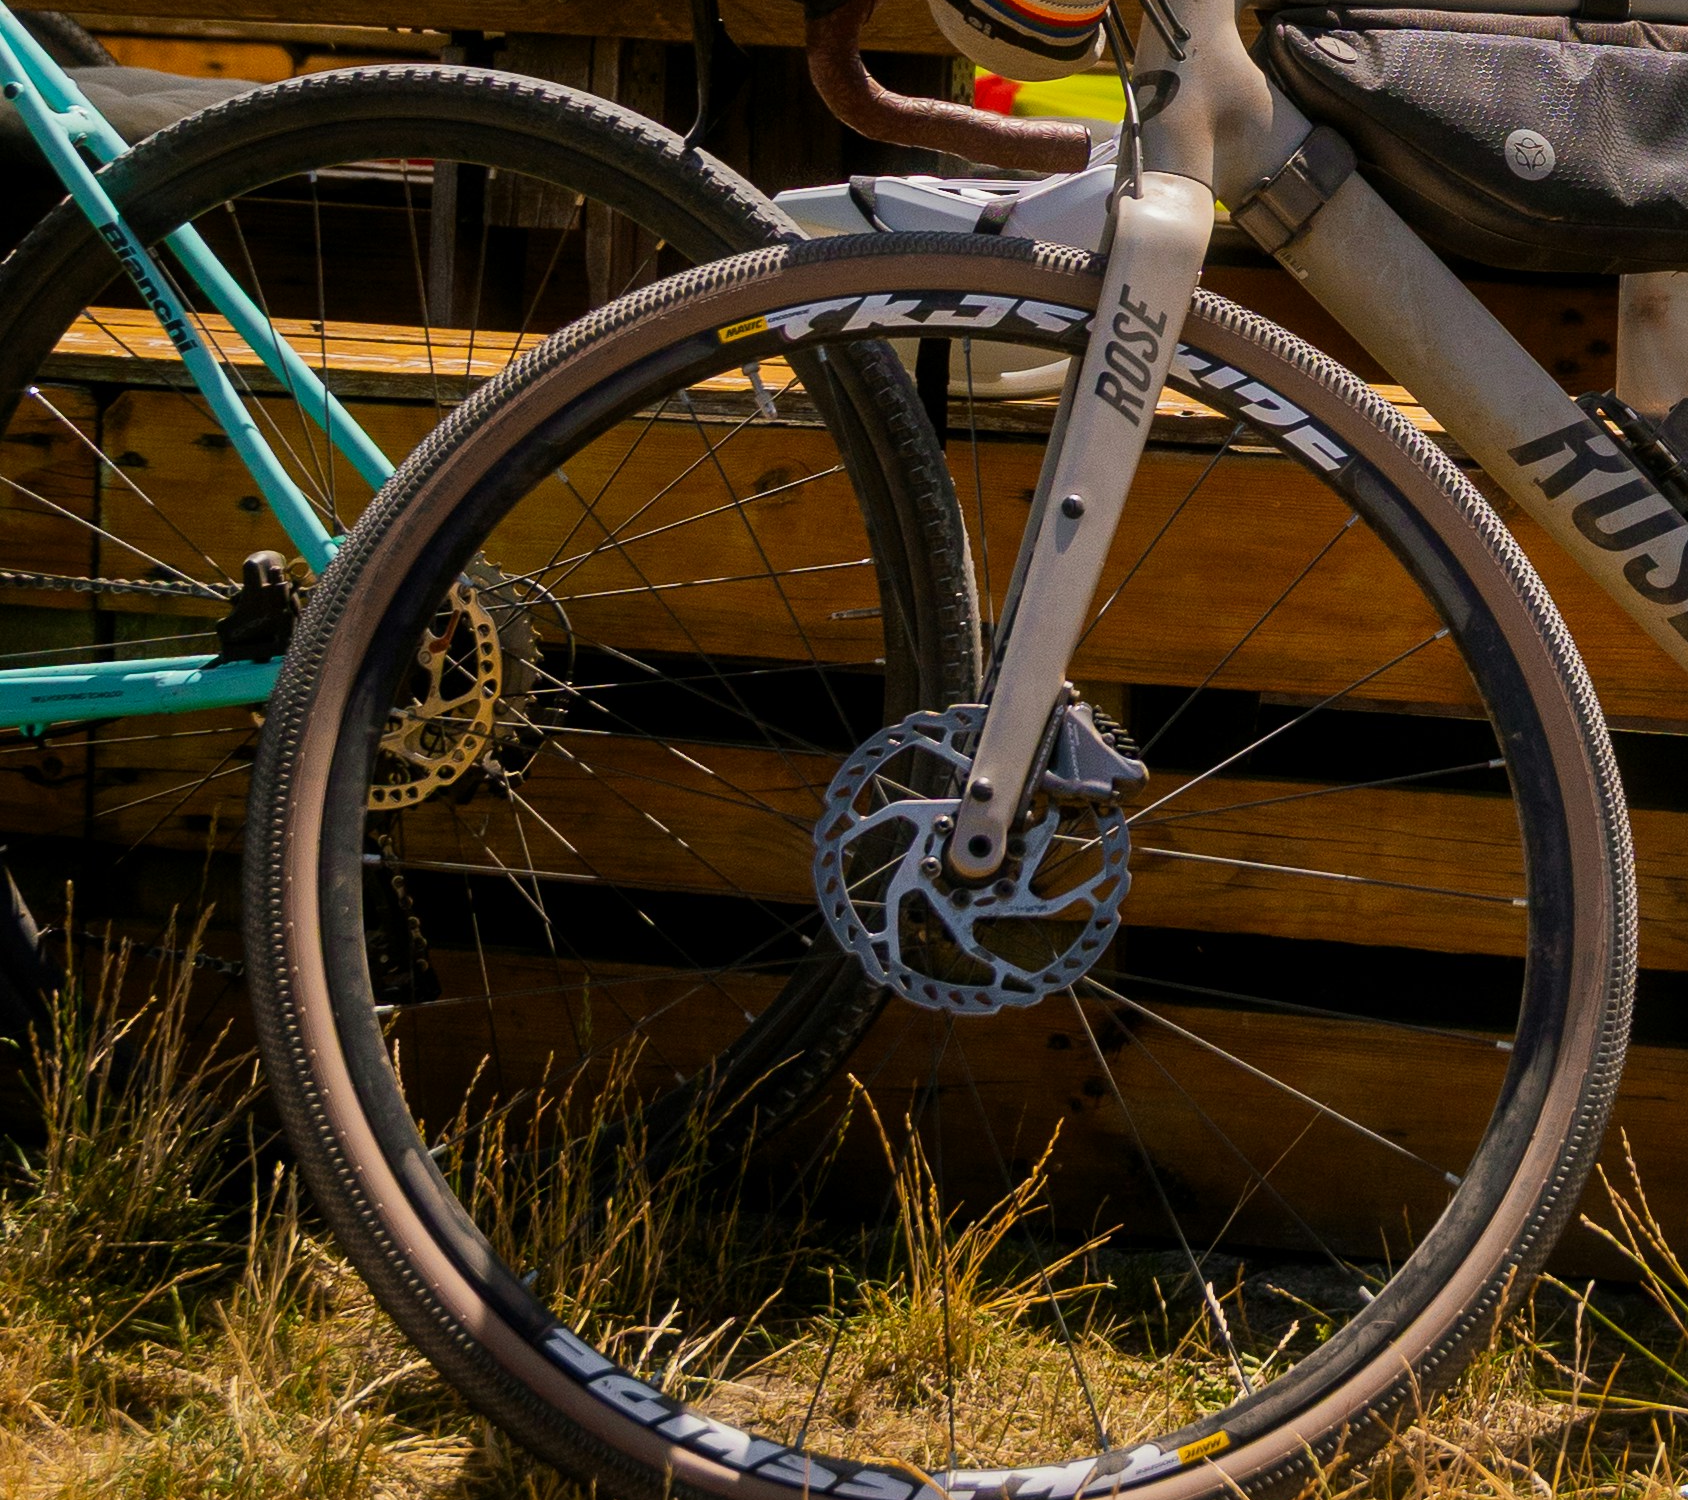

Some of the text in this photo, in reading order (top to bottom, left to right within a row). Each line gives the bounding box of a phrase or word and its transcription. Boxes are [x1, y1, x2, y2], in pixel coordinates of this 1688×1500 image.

[98, 221, 199, 354] Bianchi
[724, 318, 764, 339] MAVIC
[1095, 283, 1168, 427] ROSE
[1184, 1437, 1222, 1460] MAVIC
